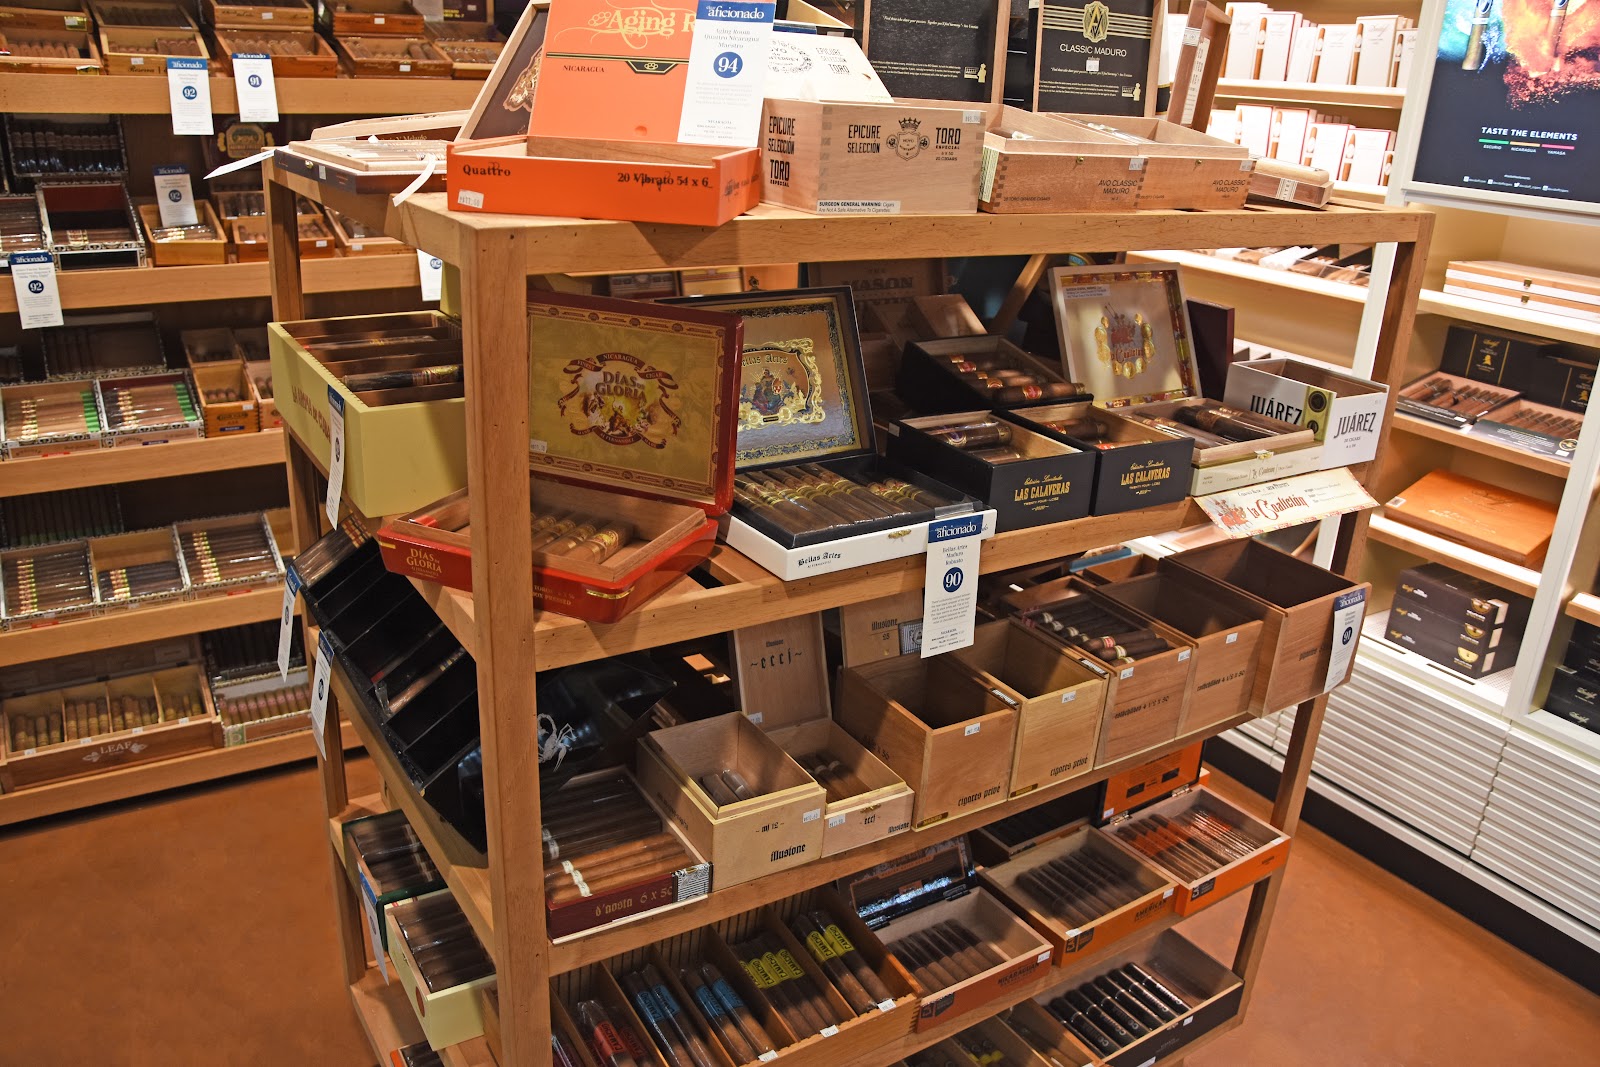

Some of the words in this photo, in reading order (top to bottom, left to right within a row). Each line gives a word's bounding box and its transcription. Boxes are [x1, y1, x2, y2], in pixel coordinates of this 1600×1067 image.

[708, 5, 765, 20] aficionado
[606, 9, 675, 37] Aging
[704, 34, 727, 42] Quattro
[1060, 43, 1093, 54] CLASSIC
[1094, 47, 1127, 57] MADURO
[172, 61, 203, 69] aficionado
[563, 64, 605, 73] NICARAGUA
[718, 57, 738, 73] 94
[828, 63, 850, 73] TORO
[249, 76, 260, 86] 91
[184, 88, 196, 98] 92
[769, 116, 796, 136] EPICURE
[848, 124, 881, 139] EPICURE
[1481, 127, 1508, 136] TASTE
[1511, 129, 1528, 137] THE
[1530, 131, 1578, 141] ELEMENTS
[936, 127, 962, 145] TORO
[768, 136, 795, 155] SELECCIÓN
[848, 140, 881, 153] SELECCIÓN
[463, 162, 511, 176] Quattro
[770, 159, 791, 181] TORO
[617, 172, 630, 182] 20
[634, 171, 674, 191] Vibrato
[677, 176, 689, 186] 54
[170, 192, 181, 201] 92
[16, 256, 48, 264] aficionado
[30, 282, 42, 291] 92
[577, 360, 595, 371] FINEST
[603, 353, 638, 366] NICARAGUA
[765, 354, 788, 363] Artes
[602, 371, 638, 387] DÍAS
[595, 382, 647, 401] GLORIA
[1251, 394, 1303, 426] JUÁREZ
[1333, 412, 1376, 439] JUÁREZ
[1121, 473, 1135, 485] LAS
[1136, 467, 1170, 483] CALAVERAS
[1015, 489, 1029, 501] LAS
[1030, 481, 1070, 498] CALAVERAS
[1258, 495, 1310, 521] Coalición
[936, 522, 977, 538] aficionado
[411, 548, 434, 561] DÍAS
[798, 555, 820, 567] Bellas
[822, 551, 842, 560] Artes
[945, 558, 963, 566] Robusto
[406, 556, 442, 573] GLORIA
[946, 571, 962, 588] 90
[871, 617, 898, 631] illusione
[100, 741, 132, 754] LEAF
[958, 792, 981, 807] cigares
[984, 781, 1001, 798] privé
[888, 822, 909, 833] illusione
[770, 844, 806, 862] illusione
[640, 892, 648, 904] 6
[650, 891, 657, 901] x
[1135, 900, 1167, 919] AMERICAN
[811, 933, 833, 957] CAMACHO
[830, 925, 851, 949] CAMACHO
[766, 953, 787, 978] CAMACHO
[781, 951, 803, 976] CAMACHO
[753, 960, 775, 985] CAMACHO
[601, 1023, 625, 1051] CAMACHO
